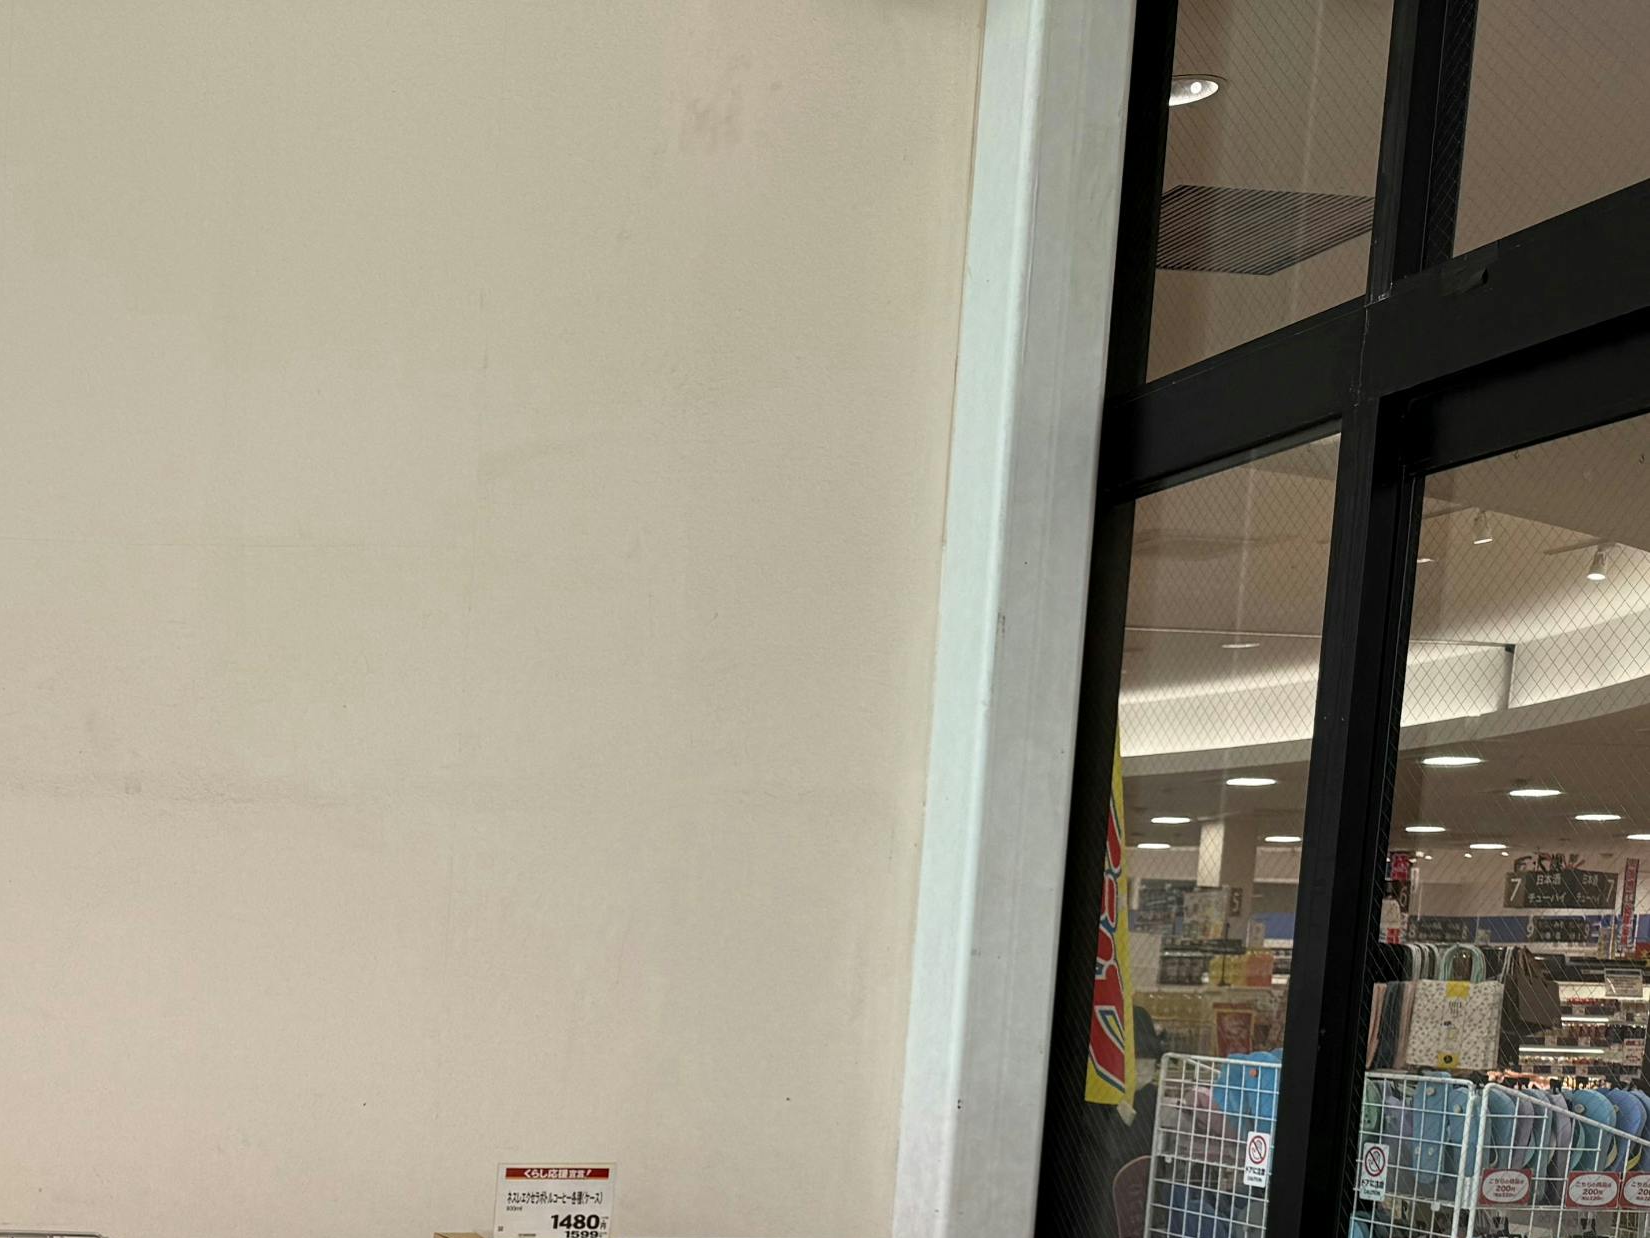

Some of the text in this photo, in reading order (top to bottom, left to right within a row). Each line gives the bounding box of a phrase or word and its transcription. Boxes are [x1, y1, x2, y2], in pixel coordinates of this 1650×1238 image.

[1510, 877, 1522, 902] 7
[550, 1214, 600, 1230] 1480
[564, 1230, 599, 1238] 1599
